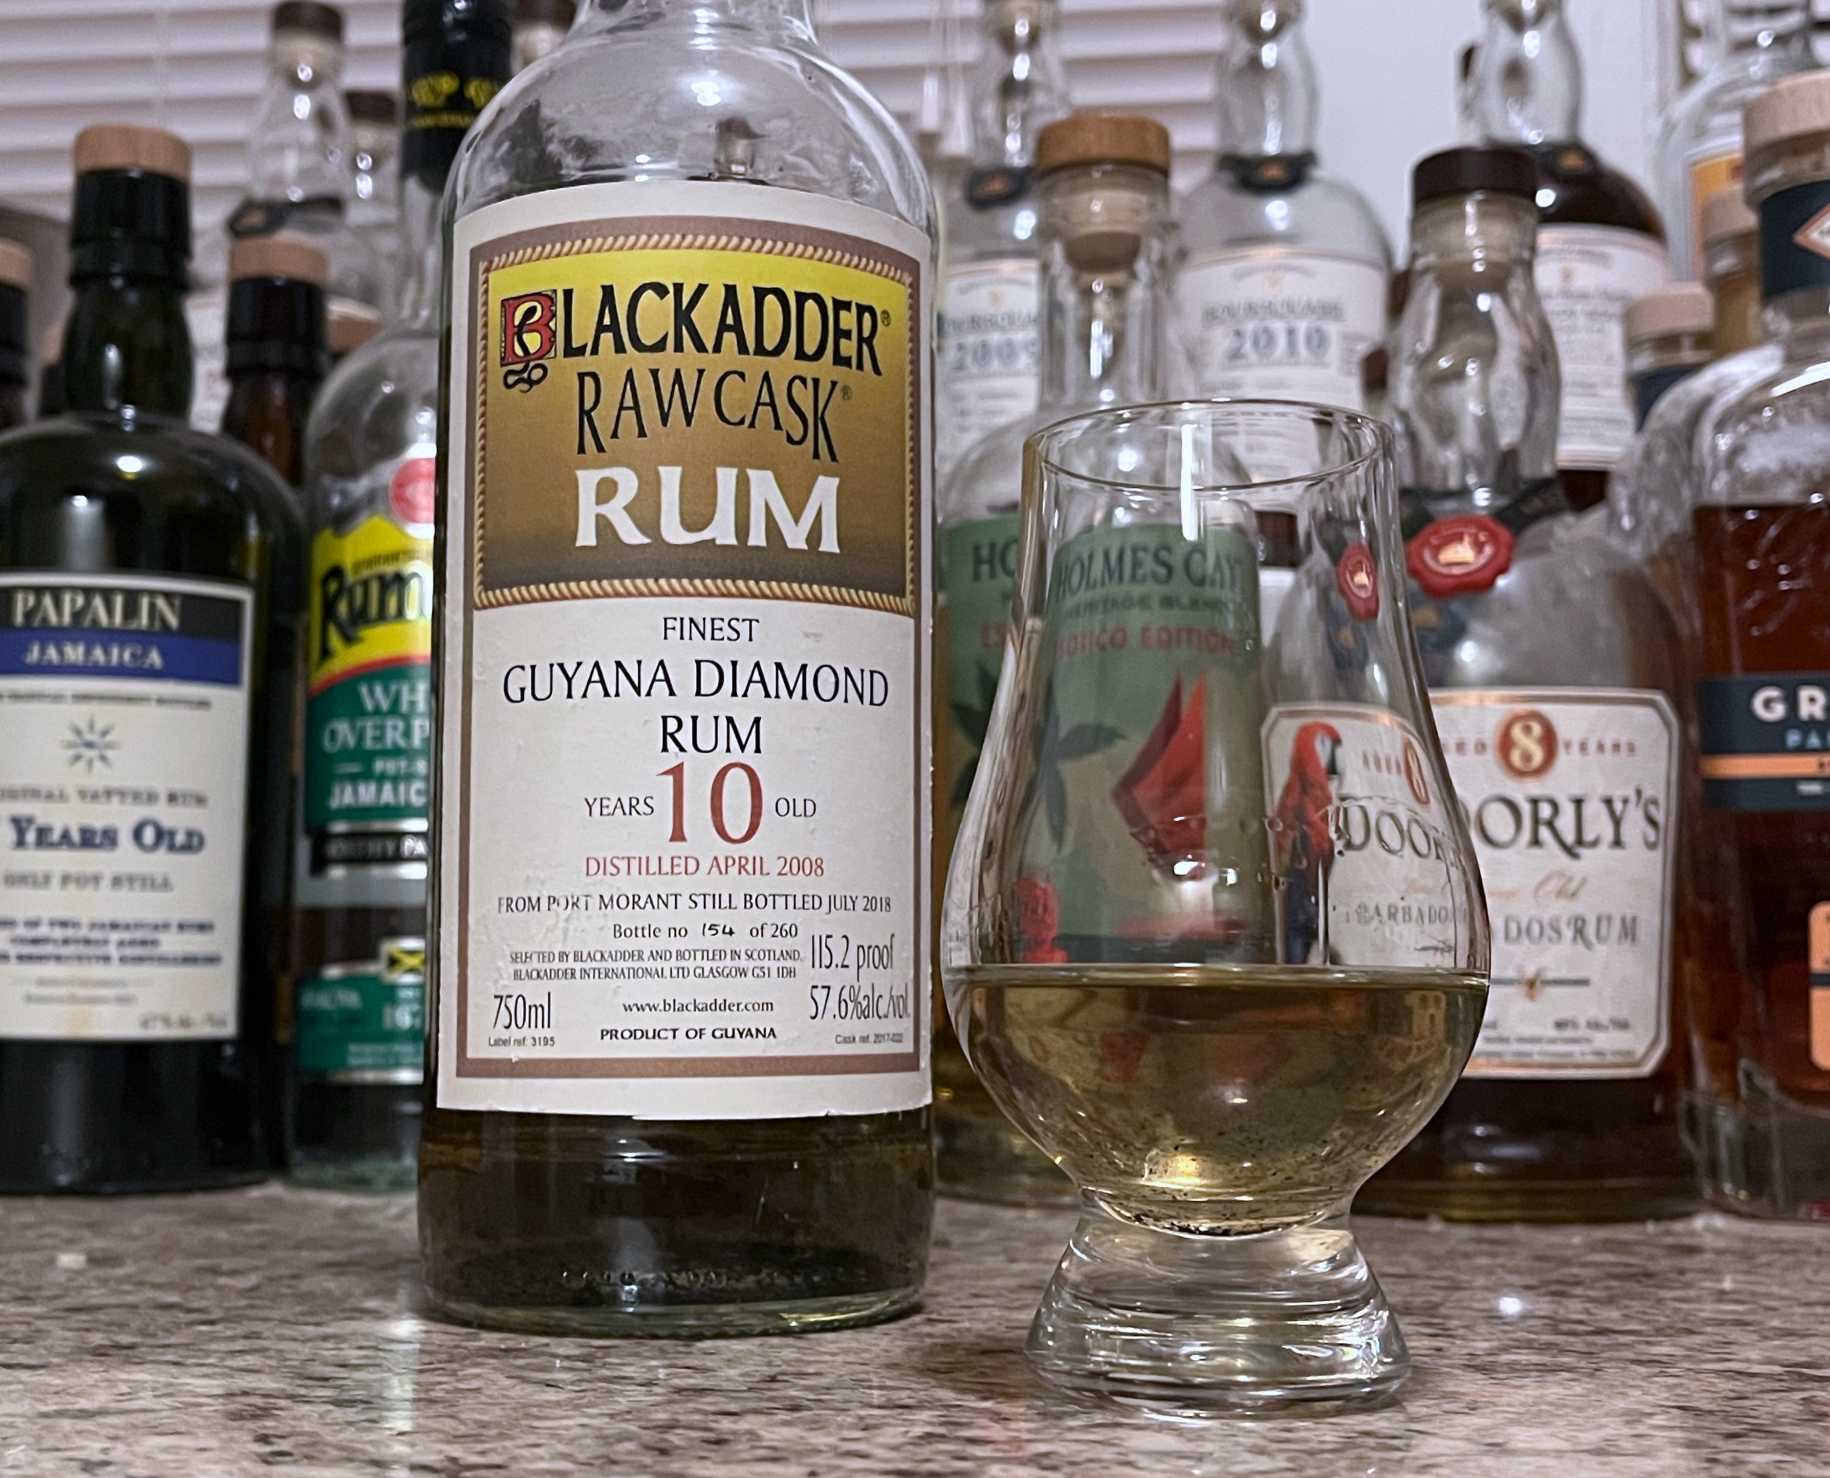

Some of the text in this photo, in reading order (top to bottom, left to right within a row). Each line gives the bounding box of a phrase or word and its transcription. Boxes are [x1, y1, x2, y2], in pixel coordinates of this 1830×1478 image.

[500, 282, 883, 376] BLACKADDER
[1227, 326, 1329, 359] 2010
[575, 465, 841, 554] RUM
[1057, 544, 1174, 597] HOLMES
[13, 590, 181, 630] PAPALIN
[663, 617, 760, 641] FINEST
[25, 640, 164, 669] JAMAICA
[503, 658, 888, 707] GUYANA DIAMOND
[660, 716, 762, 753] RUM
[584, 761, 817, 845] YEARS 10 OLD
[1460, 785, 1661, 860] ORLY'S
[585, 855, 825, 877] DISTILLED APRIL 2008
[498, 895, 541, 914] FROM
[599, 893, 682, 911] MORANT
[688, 893, 737, 910] STILL
[744, 893, 822, 911] BOTTLED
[824, 895, 858, 915] JULY
[862, 896, 891, 912] 2018
[613, 923, 798, 938] Bottle no 154 of 260
[510, 951, 555, 963] SELECTED
[558, 951, 570, 963] BY
[573, 949, 644, 962] BLACKADDER
[648, 949, 672, 961] AND
[675, 949, 727, 961] BOTTLED
[730, 949, 741, 961] IN
[811, 933, 895, 983] 115.2 proof
[513, 968, 577, 981] BLACKADDER
[580, 966, 666, 980] INTERNATIONAL
[669, 966, 690, 979] LTD
[693, 966, 748, 979] GLASGOW
[493, 991, 551, 1030] 750ml
[622, 998, 774, 1013] www.blackadder.com
[488, 1036, 511, 1048] Label
[531, 1036, 555, 1047] 3195
[600, 1027, 777, 1041] PRODUCT OF GUYANA
